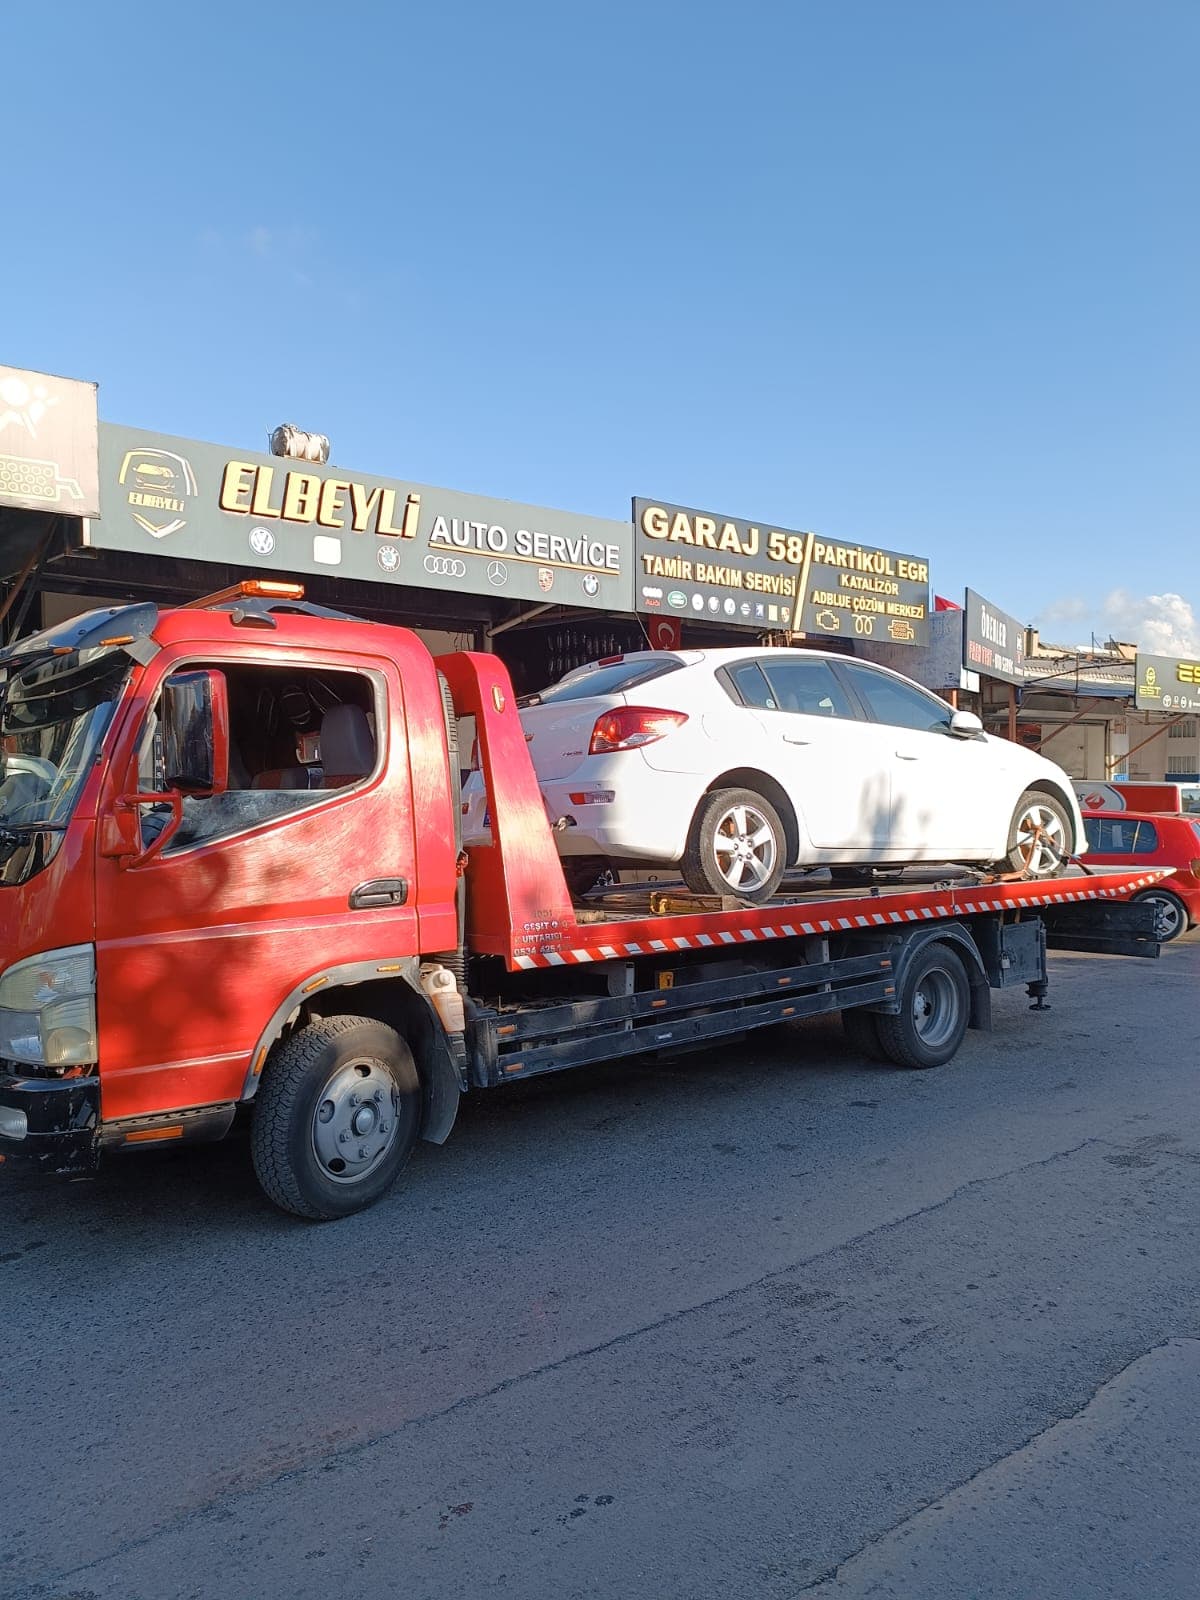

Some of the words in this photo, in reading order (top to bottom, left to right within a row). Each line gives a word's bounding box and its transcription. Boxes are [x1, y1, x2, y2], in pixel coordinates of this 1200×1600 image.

[430, 516, 508, 551] AUTO
[642, 507, 759, 556] GARAJ
[768, 532, 804, 564] 58
[641, 553, 692, 581] TAMİR
[696, 562, 742, 588] BAKIM
[813, 542, 895, 576] PARTİKÜL
[898, 559, 929, 582] EGR
[812, 590, 851, 609] ADBLUE
[852, 595, 886, 613] ÇÖZÜM
